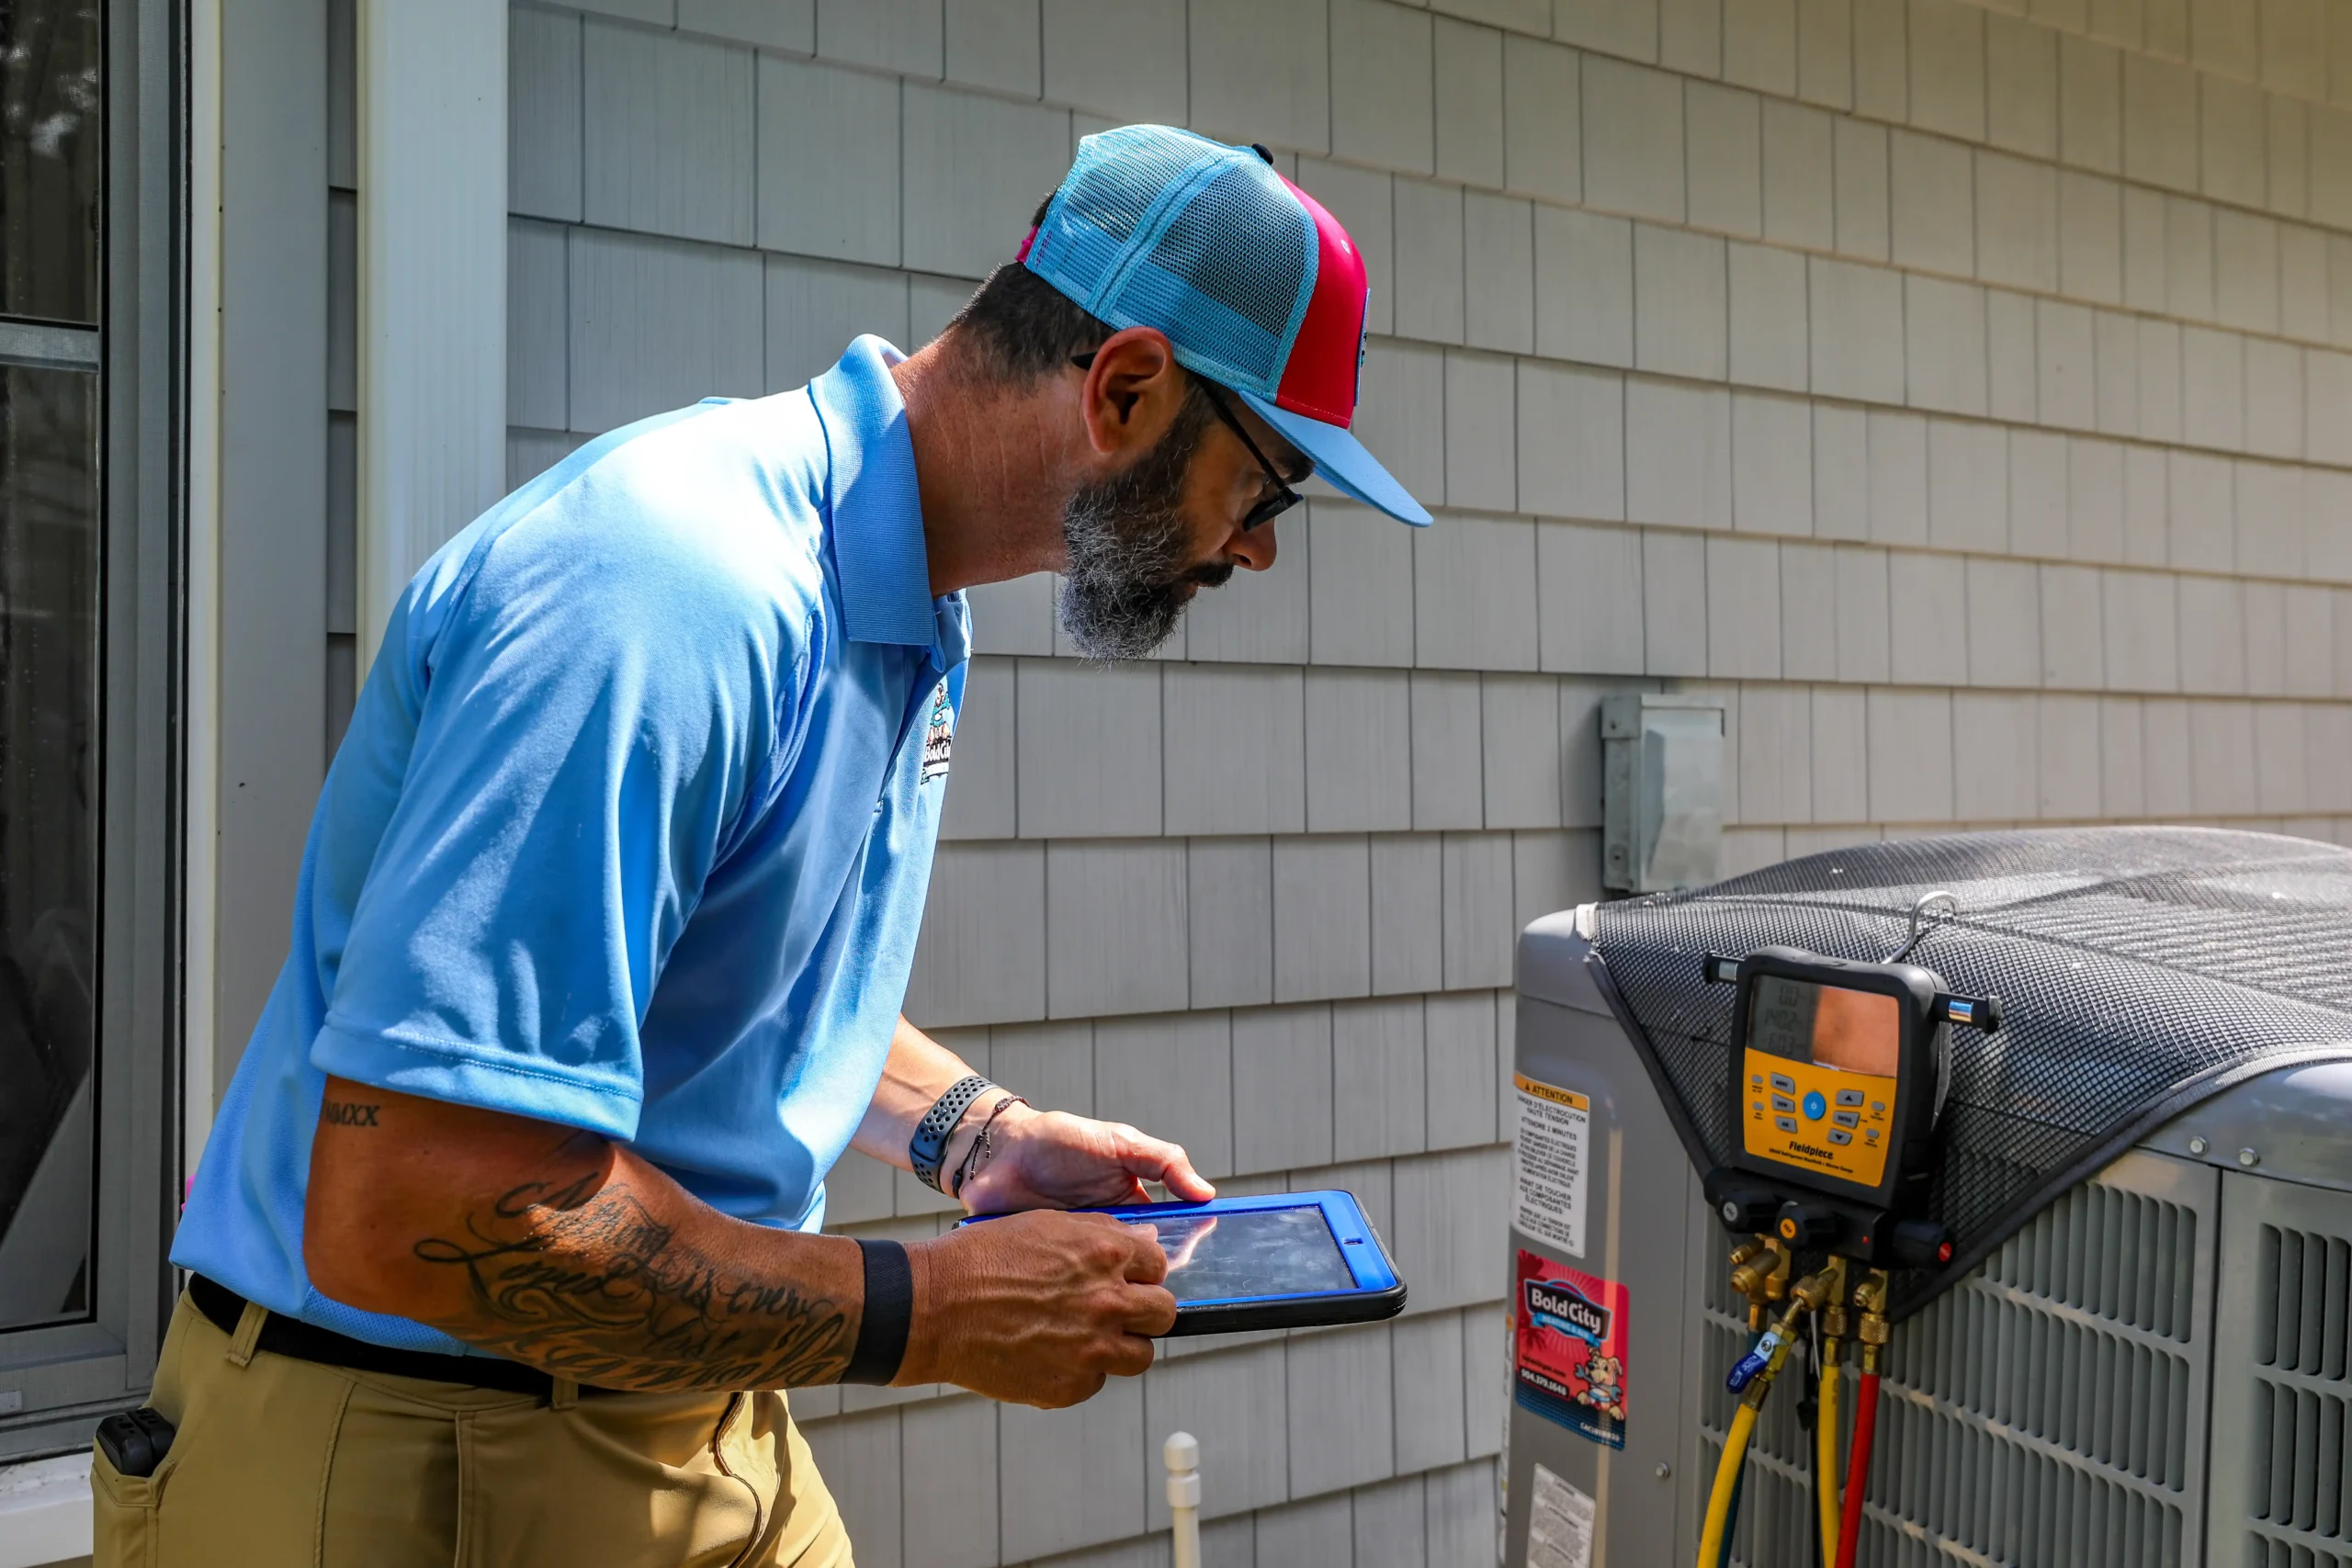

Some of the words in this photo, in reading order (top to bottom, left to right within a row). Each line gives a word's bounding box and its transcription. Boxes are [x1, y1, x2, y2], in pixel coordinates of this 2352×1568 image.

[924, 740, 951, 761] BoldCit
[1532, 1085, 1573, 1104] ATTENTION
[1544, 1111, 1569, 1125] TENSION
[1552, 1127, 1577, 1140] MINUTES
[1789, 1141, 1834, 1159] Fieldpiece
[1530, 1188, 1571, 1210] COMPOSANTES
[1545, 1185, 1571, 1201] TOUCHER
[1532, 1288, 1600, 1334] BoldCity
